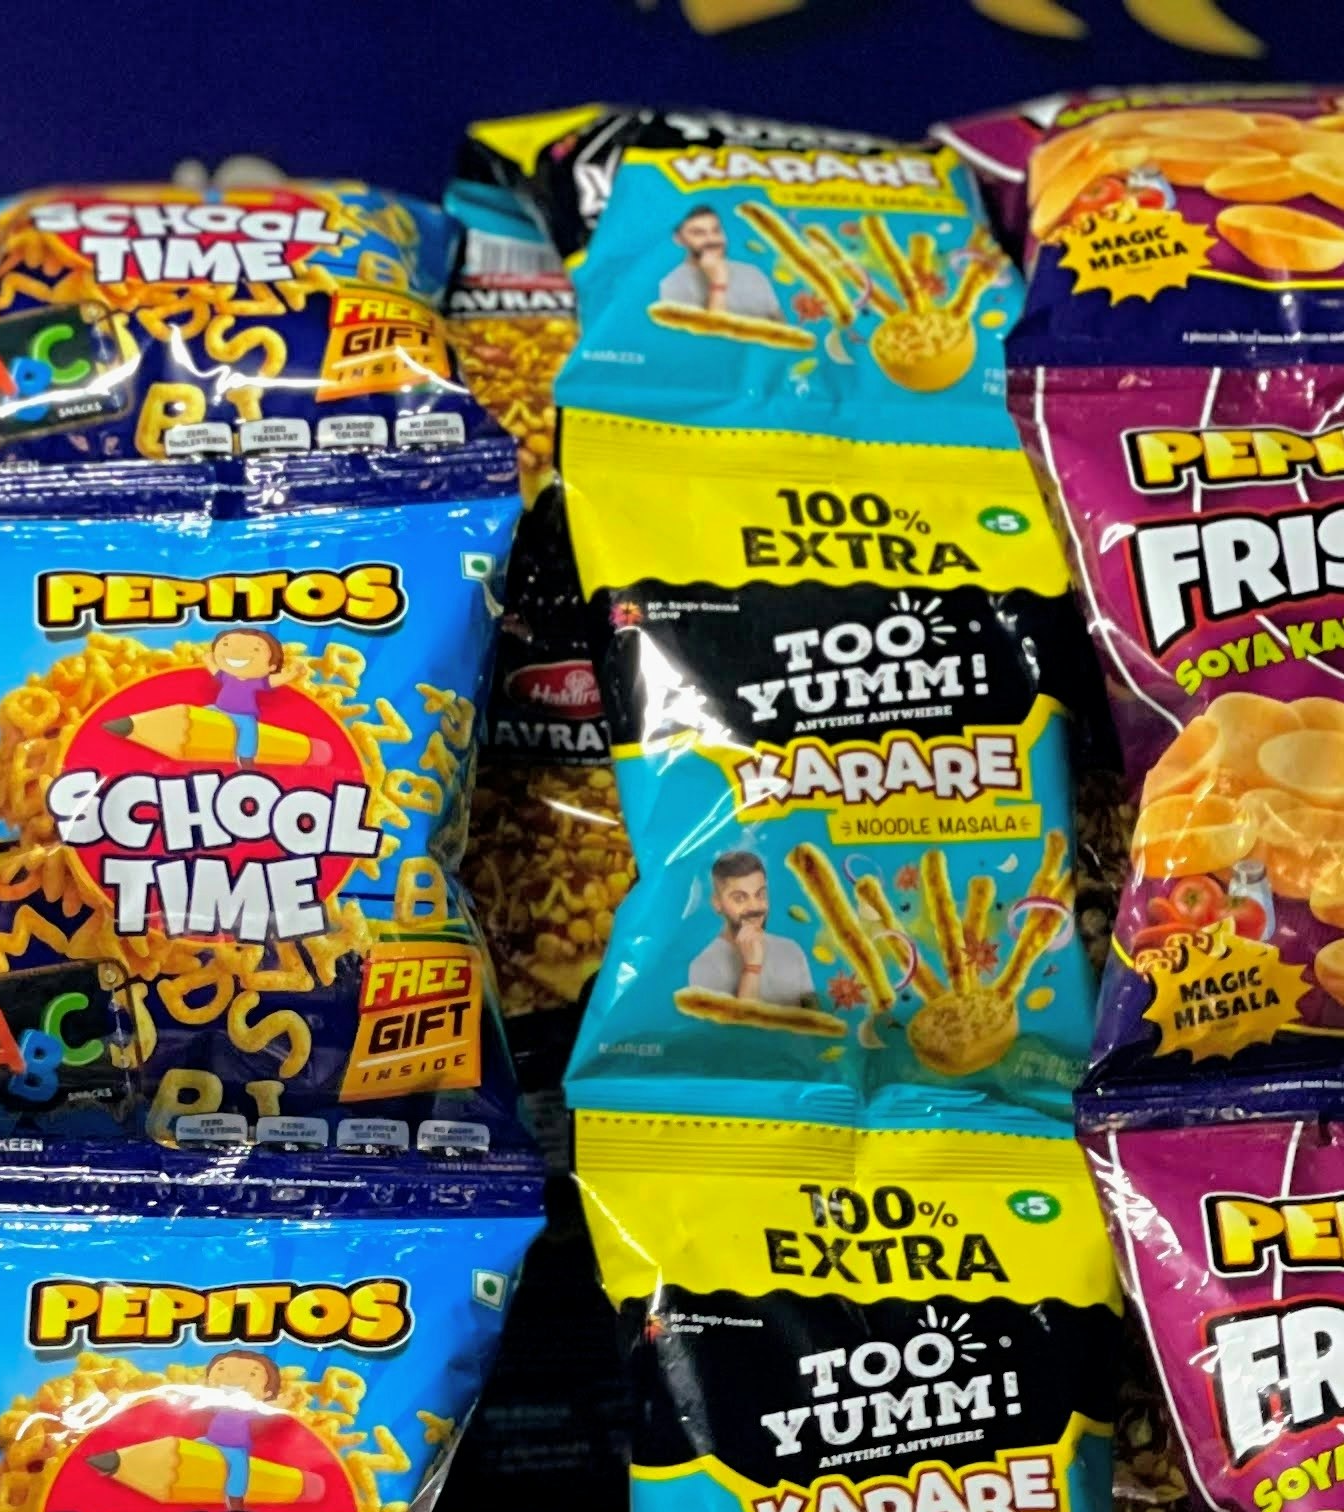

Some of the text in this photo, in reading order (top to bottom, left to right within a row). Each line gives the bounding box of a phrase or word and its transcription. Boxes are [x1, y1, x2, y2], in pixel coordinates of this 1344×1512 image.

[670, 154, 940, 189] KARARE
[31, 200, 343, 247] SCHOOL
[1090, 228, 1171, 253] MAGIC
[81, 237, 297, 284] TIME
[1089, 239, 1188, 272] MASALA
[329, 292, 434, 328] FREE
[343, 323, 434, 356] GIFT
[58, 400, 103, 418] SNACKS
[775, 489, 932, 536] 100%
[740, 527, 981, 576] EXTRA
[41, 565, 400, 626] PEPITOS
[773, 614, 926, 674] TOO
[1175, 631, 1287, 696] SOYA
[737, 653, 989, 722] YUMM!
[794, 705, 954, 733] ANYTIME ANYWHERE
[736, 733, 1019, 806] KARARE
[47, 769, 385, 860] SCHOOL
[856, 814, 1018, 837] NOODLE MASALA
[101, 855, 328, 942] TIME
[362, 959, 469, 1007] FREE
[1178, 965, 1264, 1004] MAGIC
[367, 1003, 470, 1056] GIFT
[1172, 987, 1282, 1032] MASALA
[359, 1053, 468, 1084] INSIDE
[799, 1183, 959, 1232] 100%
[764, 1229, 1010, 1285] EXTRA
[31, 1279, 409, 1347] PEPITOS
[670, 1322, 705, 1334] Group
[799, 1331, 956, 1398] TOO
[760, 1371, 1024, 1459] YUMM!
[818, 1429, 985, 1469] ANYTIME ANYWHERE
